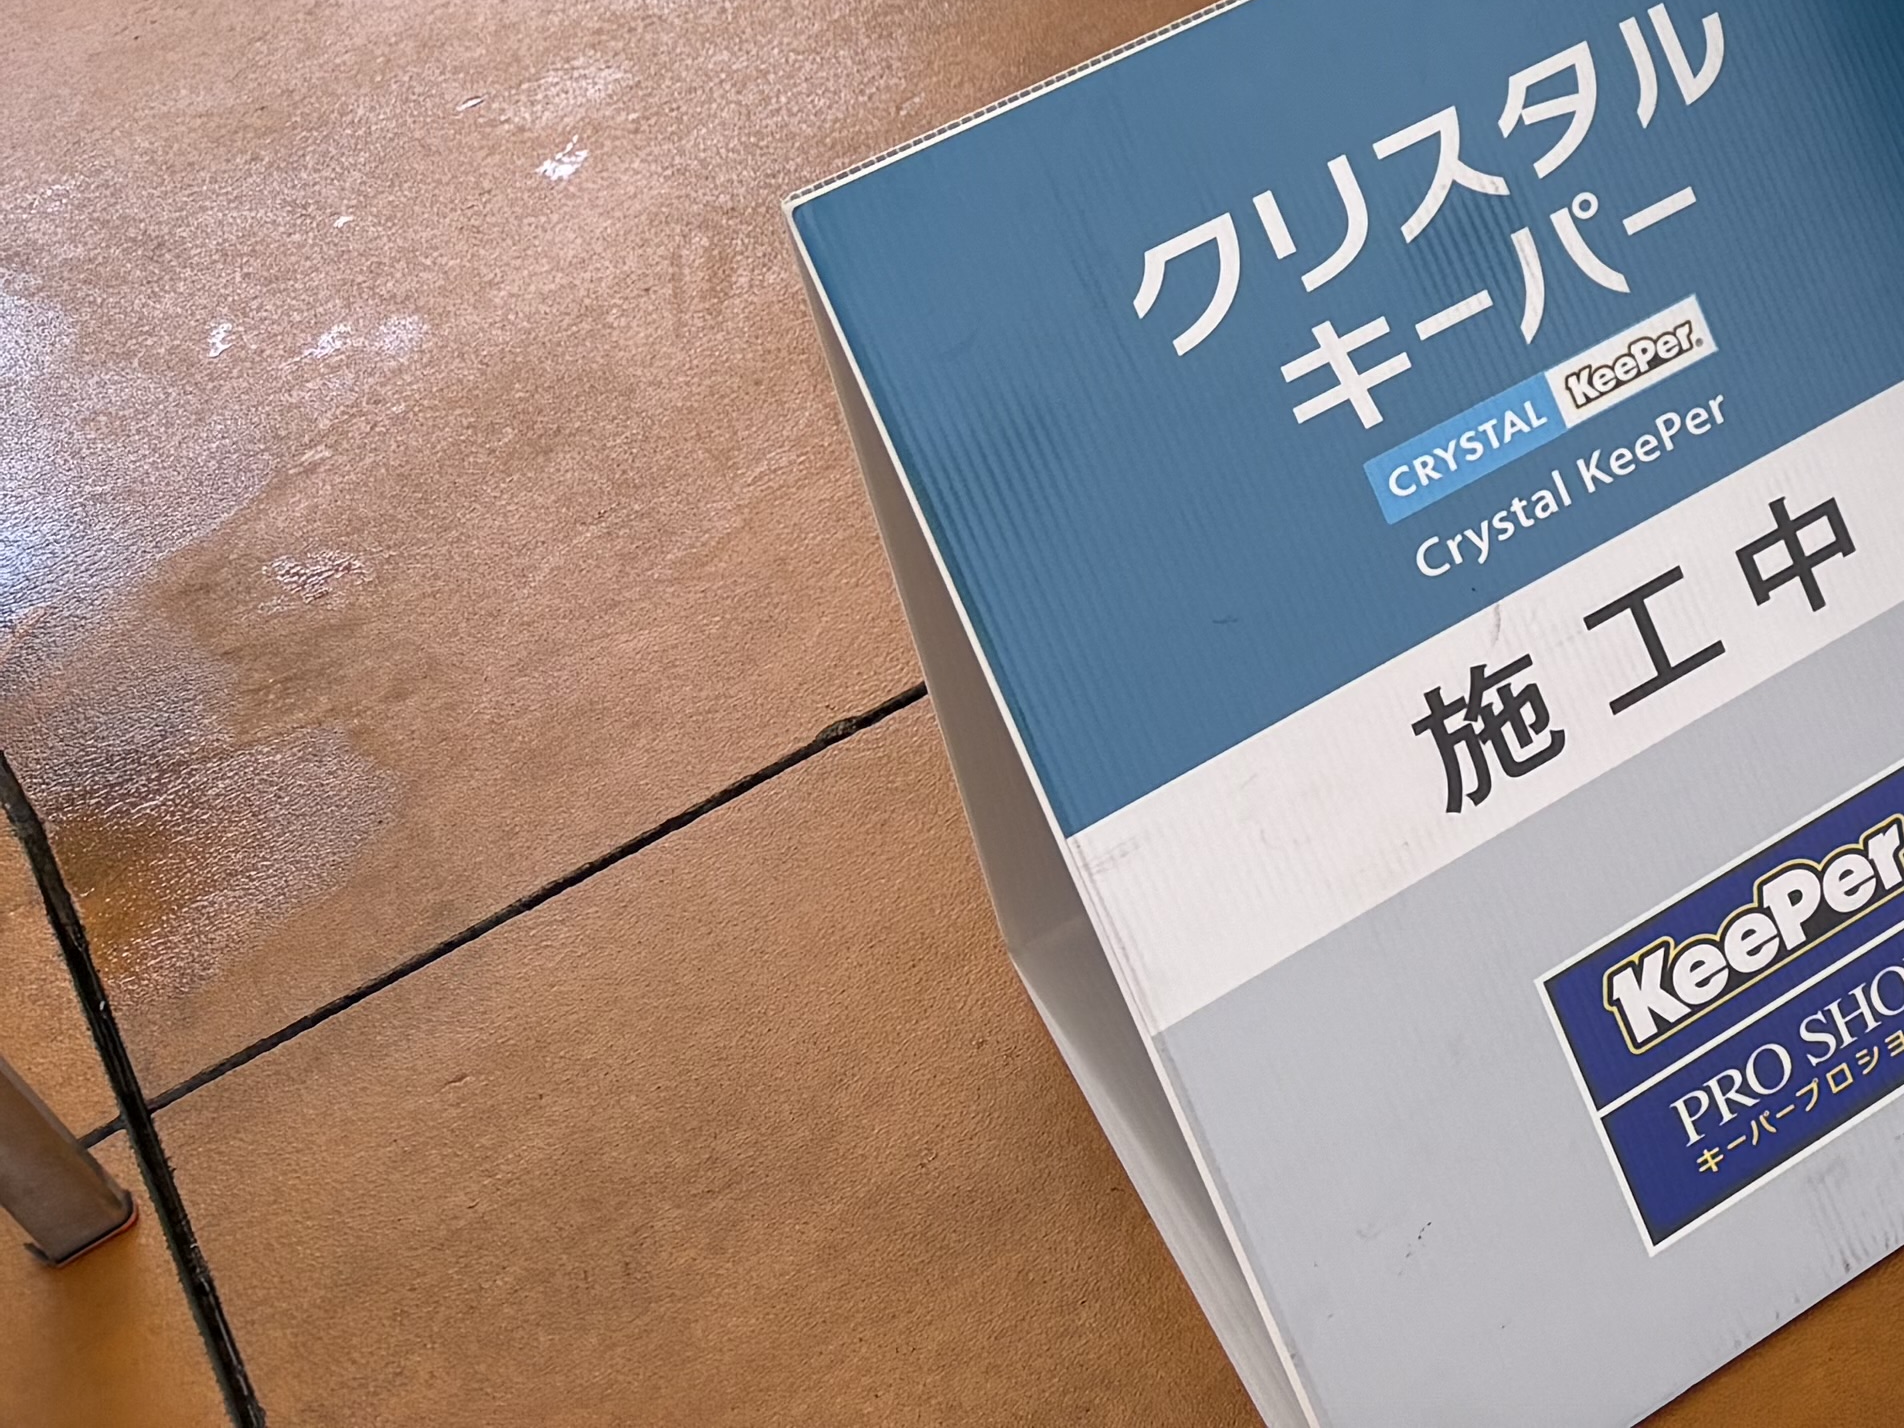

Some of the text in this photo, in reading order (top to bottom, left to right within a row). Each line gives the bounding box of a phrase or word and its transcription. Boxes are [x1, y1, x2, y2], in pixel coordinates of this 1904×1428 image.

[1132, 2, 1726, 357] クリスタル
[1280, 186, 1698, 430] キーパー
[1387, 319, 1695, 498] CRYSTAL KeePer
[1414, 393, 1725, 578] Crystal KeePer
[1411, 496, 1856, 814] 施工中
[1669, 1042, 1793, 1148] PRO
